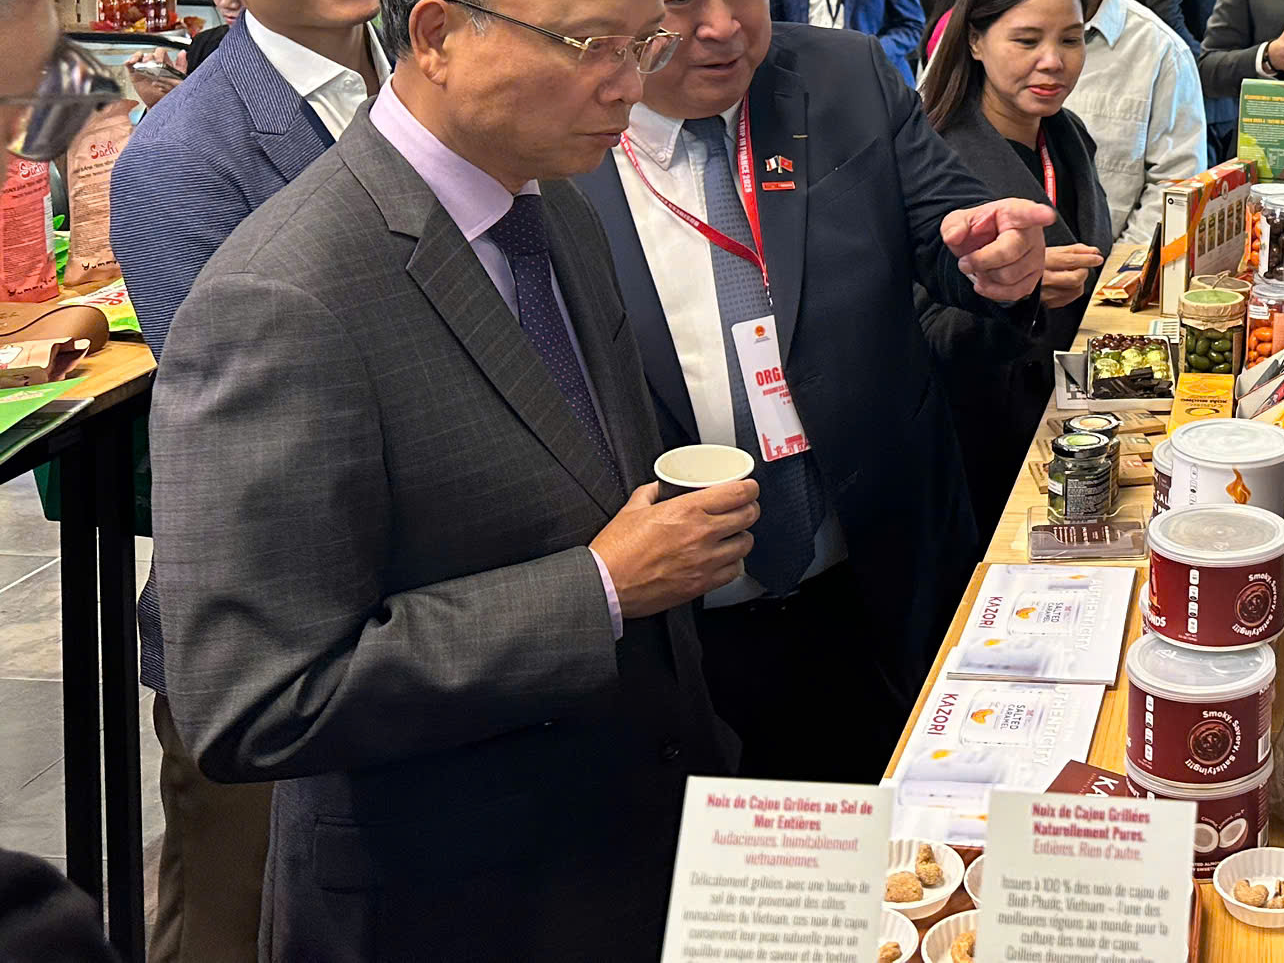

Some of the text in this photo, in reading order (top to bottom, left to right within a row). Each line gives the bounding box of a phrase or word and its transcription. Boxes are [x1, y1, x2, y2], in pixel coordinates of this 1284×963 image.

[1248, 572, 1272, 584] Smoky,
[978, 596, 1004, 629] KAZORI
[1052, 601, 1064, 623] SALTED
[927, 693, 959, 735] KAZORI
[1000, 704, 1015, 729] CARAMEL
[1010, 705, 1026, 730] SALTED
[1202, 710, 1233, 723] Smoky,
[707, 794, 873, 815] Noix de Cajou Grillées au Sel de
[1032, 803, 1150, 824] Noix de Cajou Grillées
[754, 815, 821, 831] Mer Entières
[1033, 822, 1147, 843] Naturellement Pures.
[1079, 841, 1102, 859] Rien
